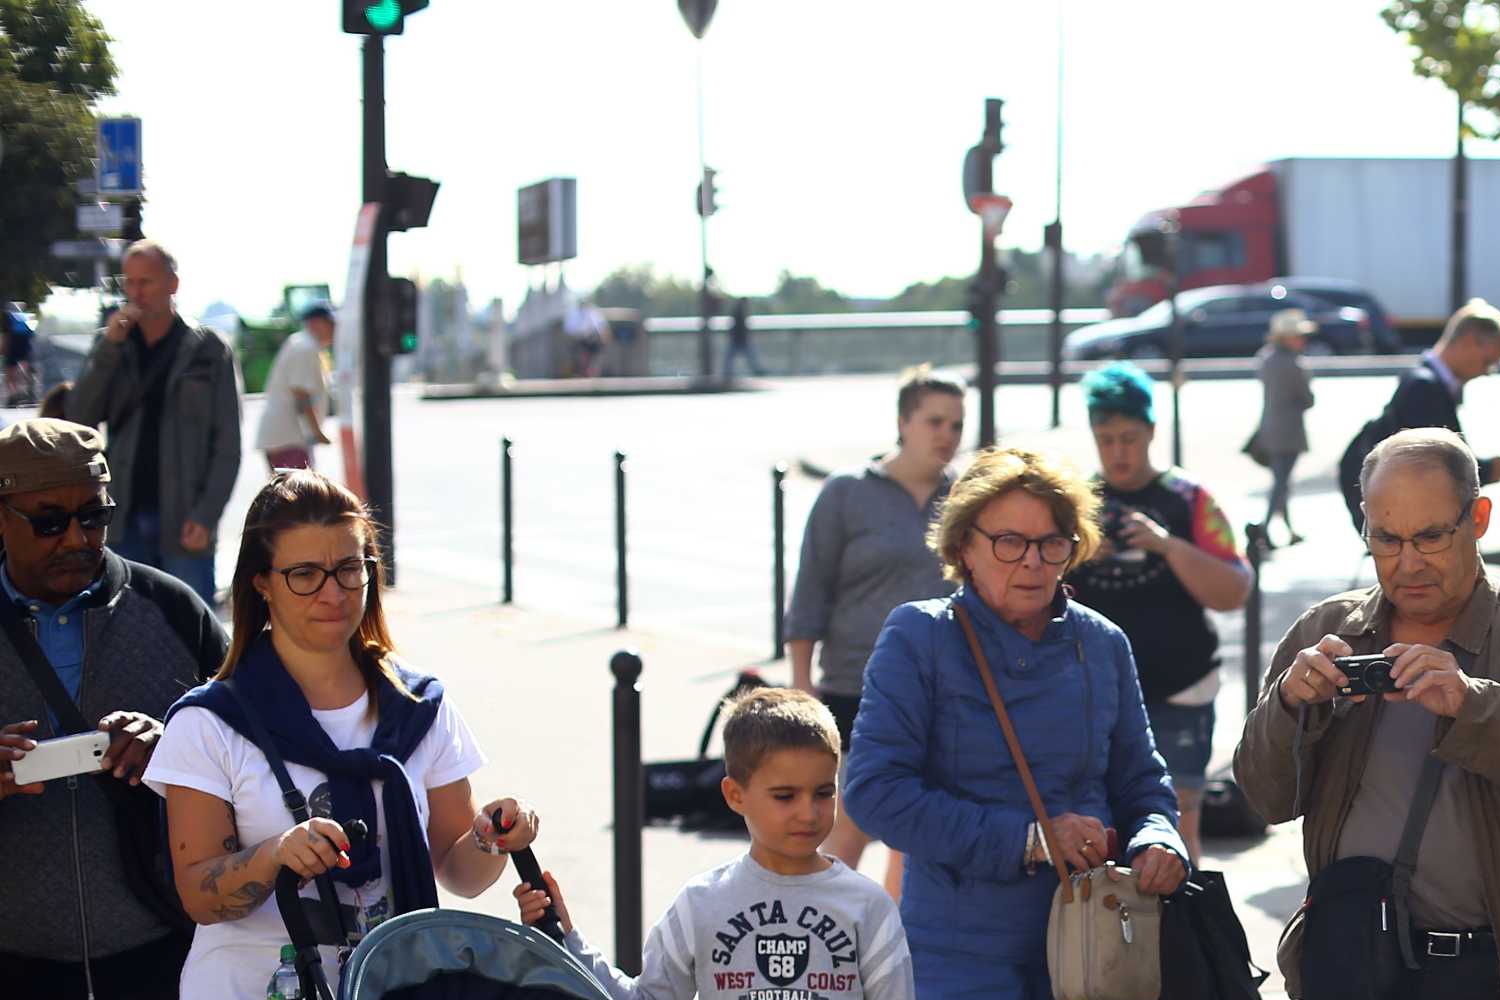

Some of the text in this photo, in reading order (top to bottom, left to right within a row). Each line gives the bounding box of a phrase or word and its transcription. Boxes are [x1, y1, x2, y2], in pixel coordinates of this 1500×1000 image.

[712, 900, 857, 968] SANTA CRUZ
[757, 939, 807, 955] CHAMP
[768, 955, 795, 978] 68
[714, 972, 856, 991] WEST COAST
